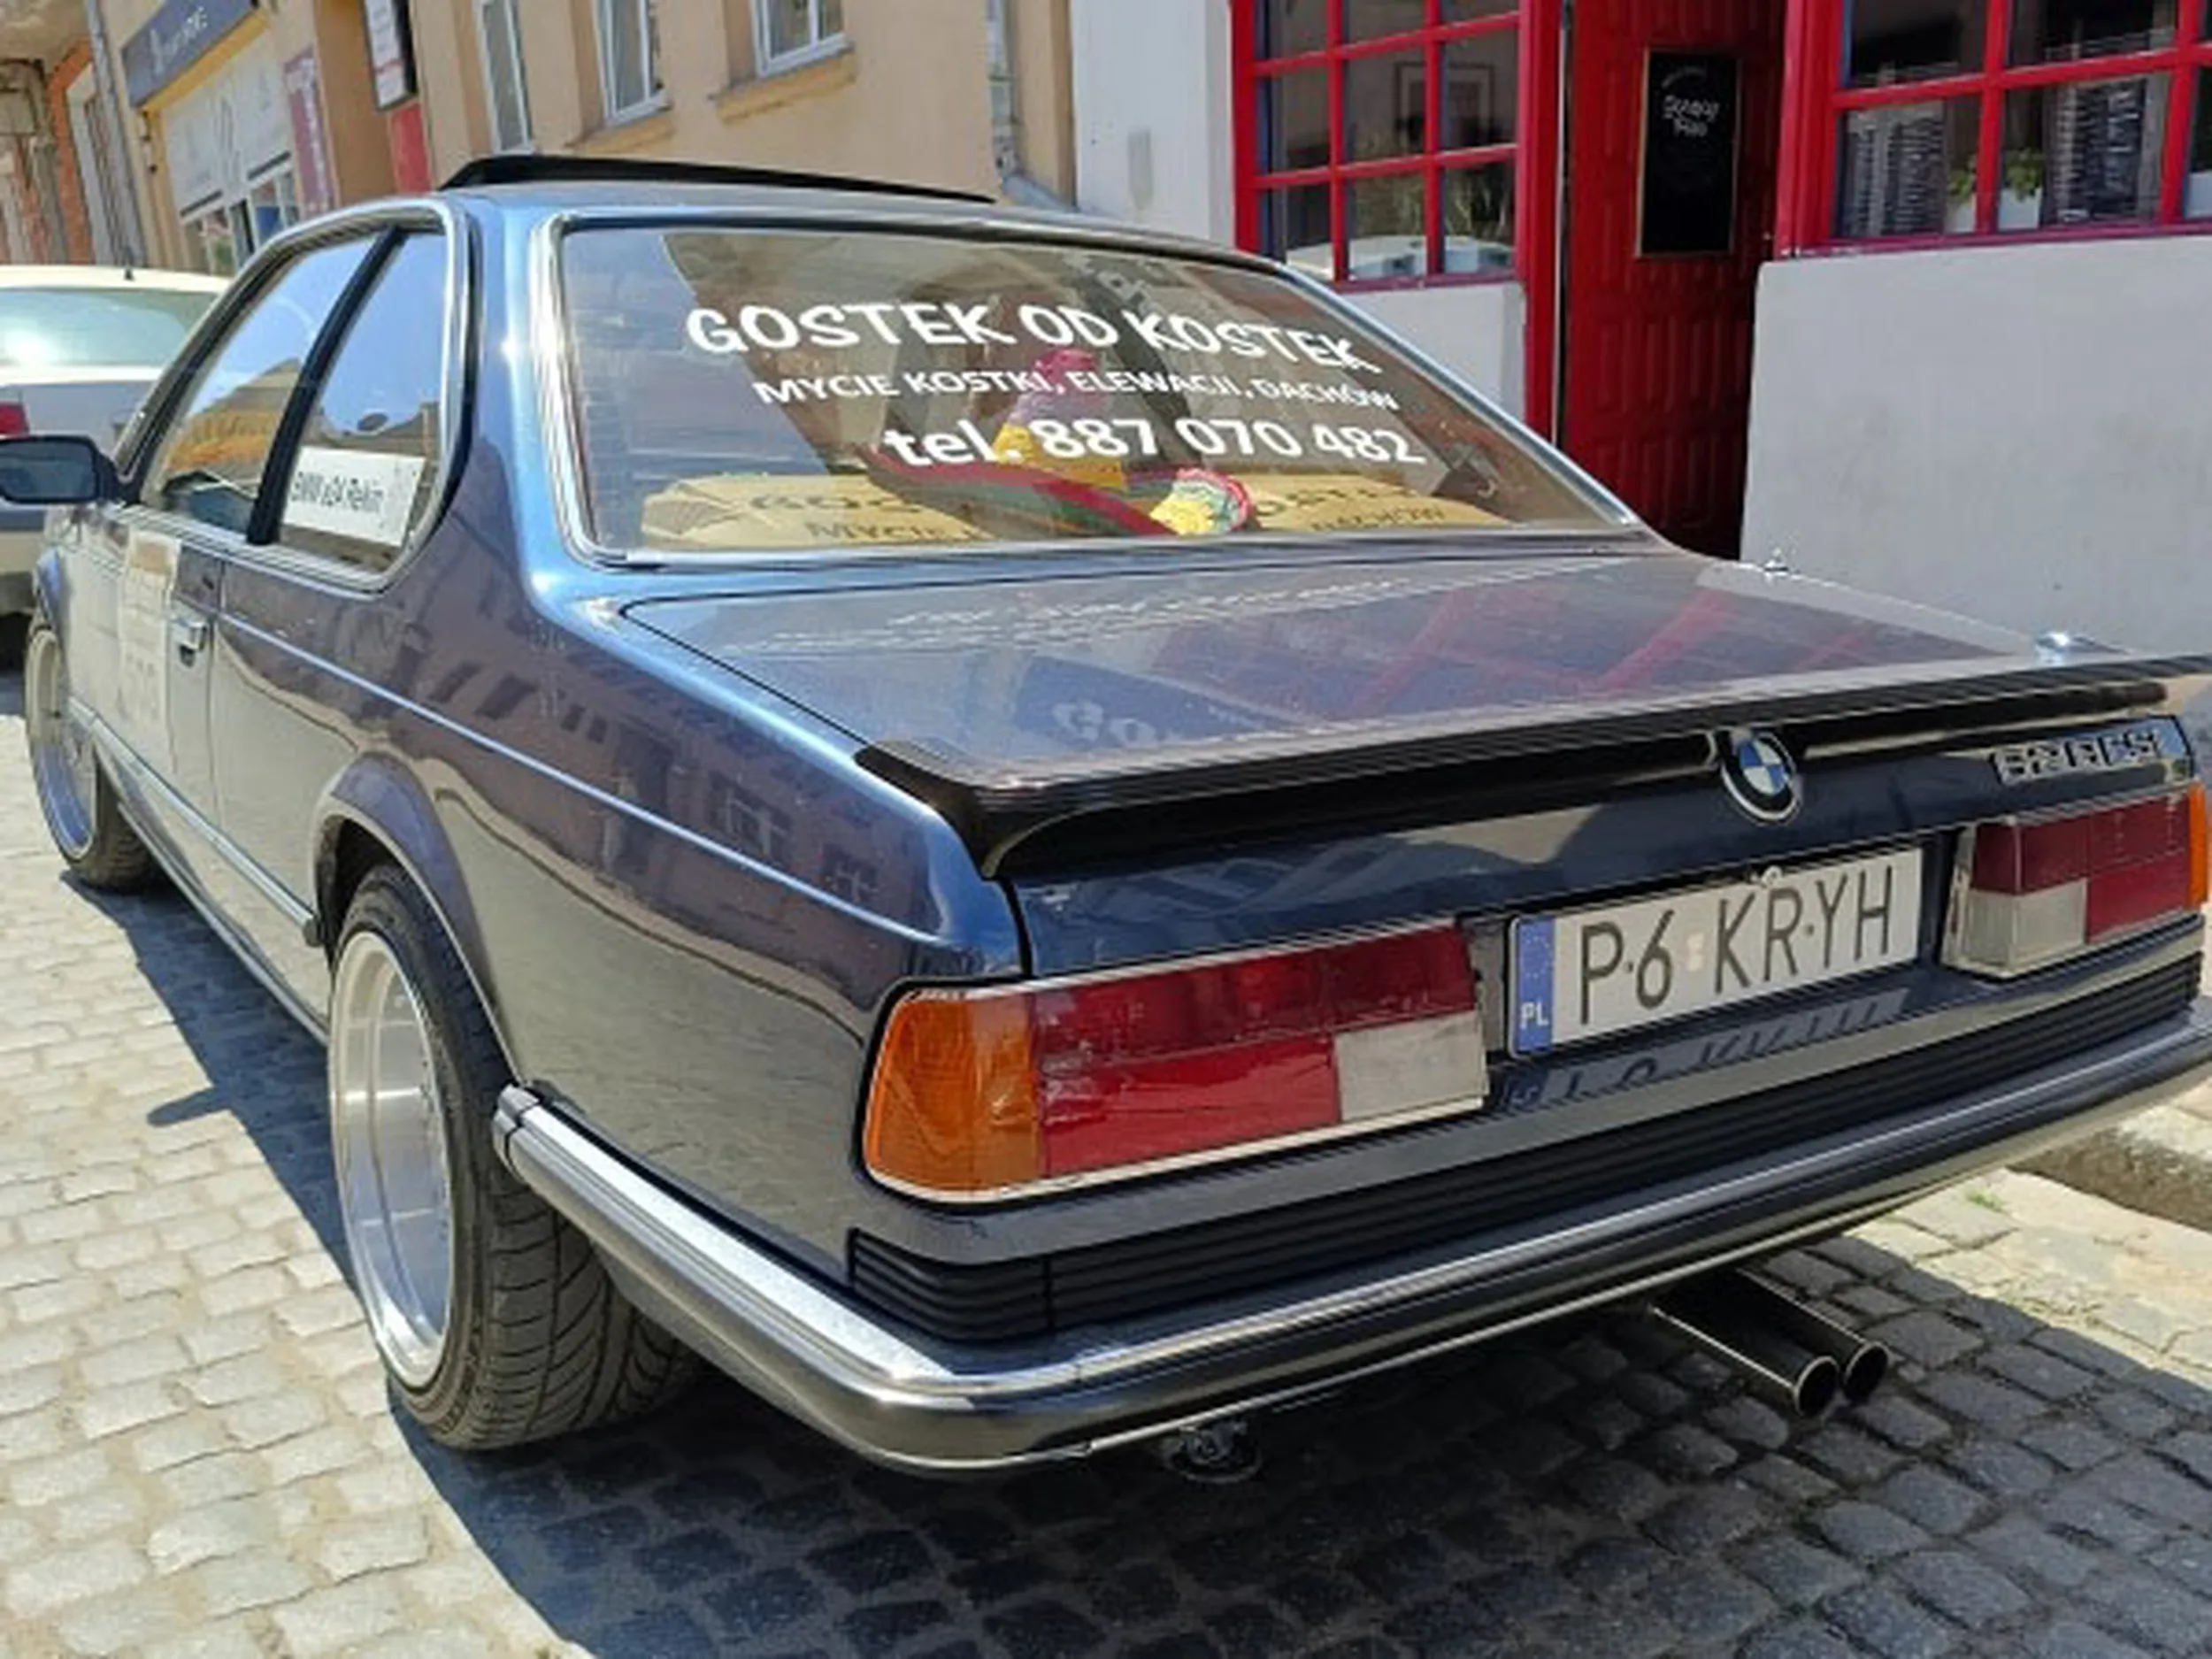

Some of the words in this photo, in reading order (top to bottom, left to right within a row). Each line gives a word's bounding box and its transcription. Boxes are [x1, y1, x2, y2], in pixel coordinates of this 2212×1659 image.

[687, 303, 1018, 353] GOSTEK
[1019, 304, 1119, 347] OD
[1121, 310, 1382, 374] KOSTEK
[752, 372, 900, 403] MYCIE
[902, 370, 1066, 395] KOSTKI,
[883, 419, 1025, 465] tel.
[1029, 418, 1158, 459] 887
[1174, 418, 1304, 457] 070
[1311, 423, 1427, 465] 482
[1578, 909, 1674, 1026] P6
[1714, 865, 1894, 995] KRYH
[1520, 1002, 1548, 1029] PL
